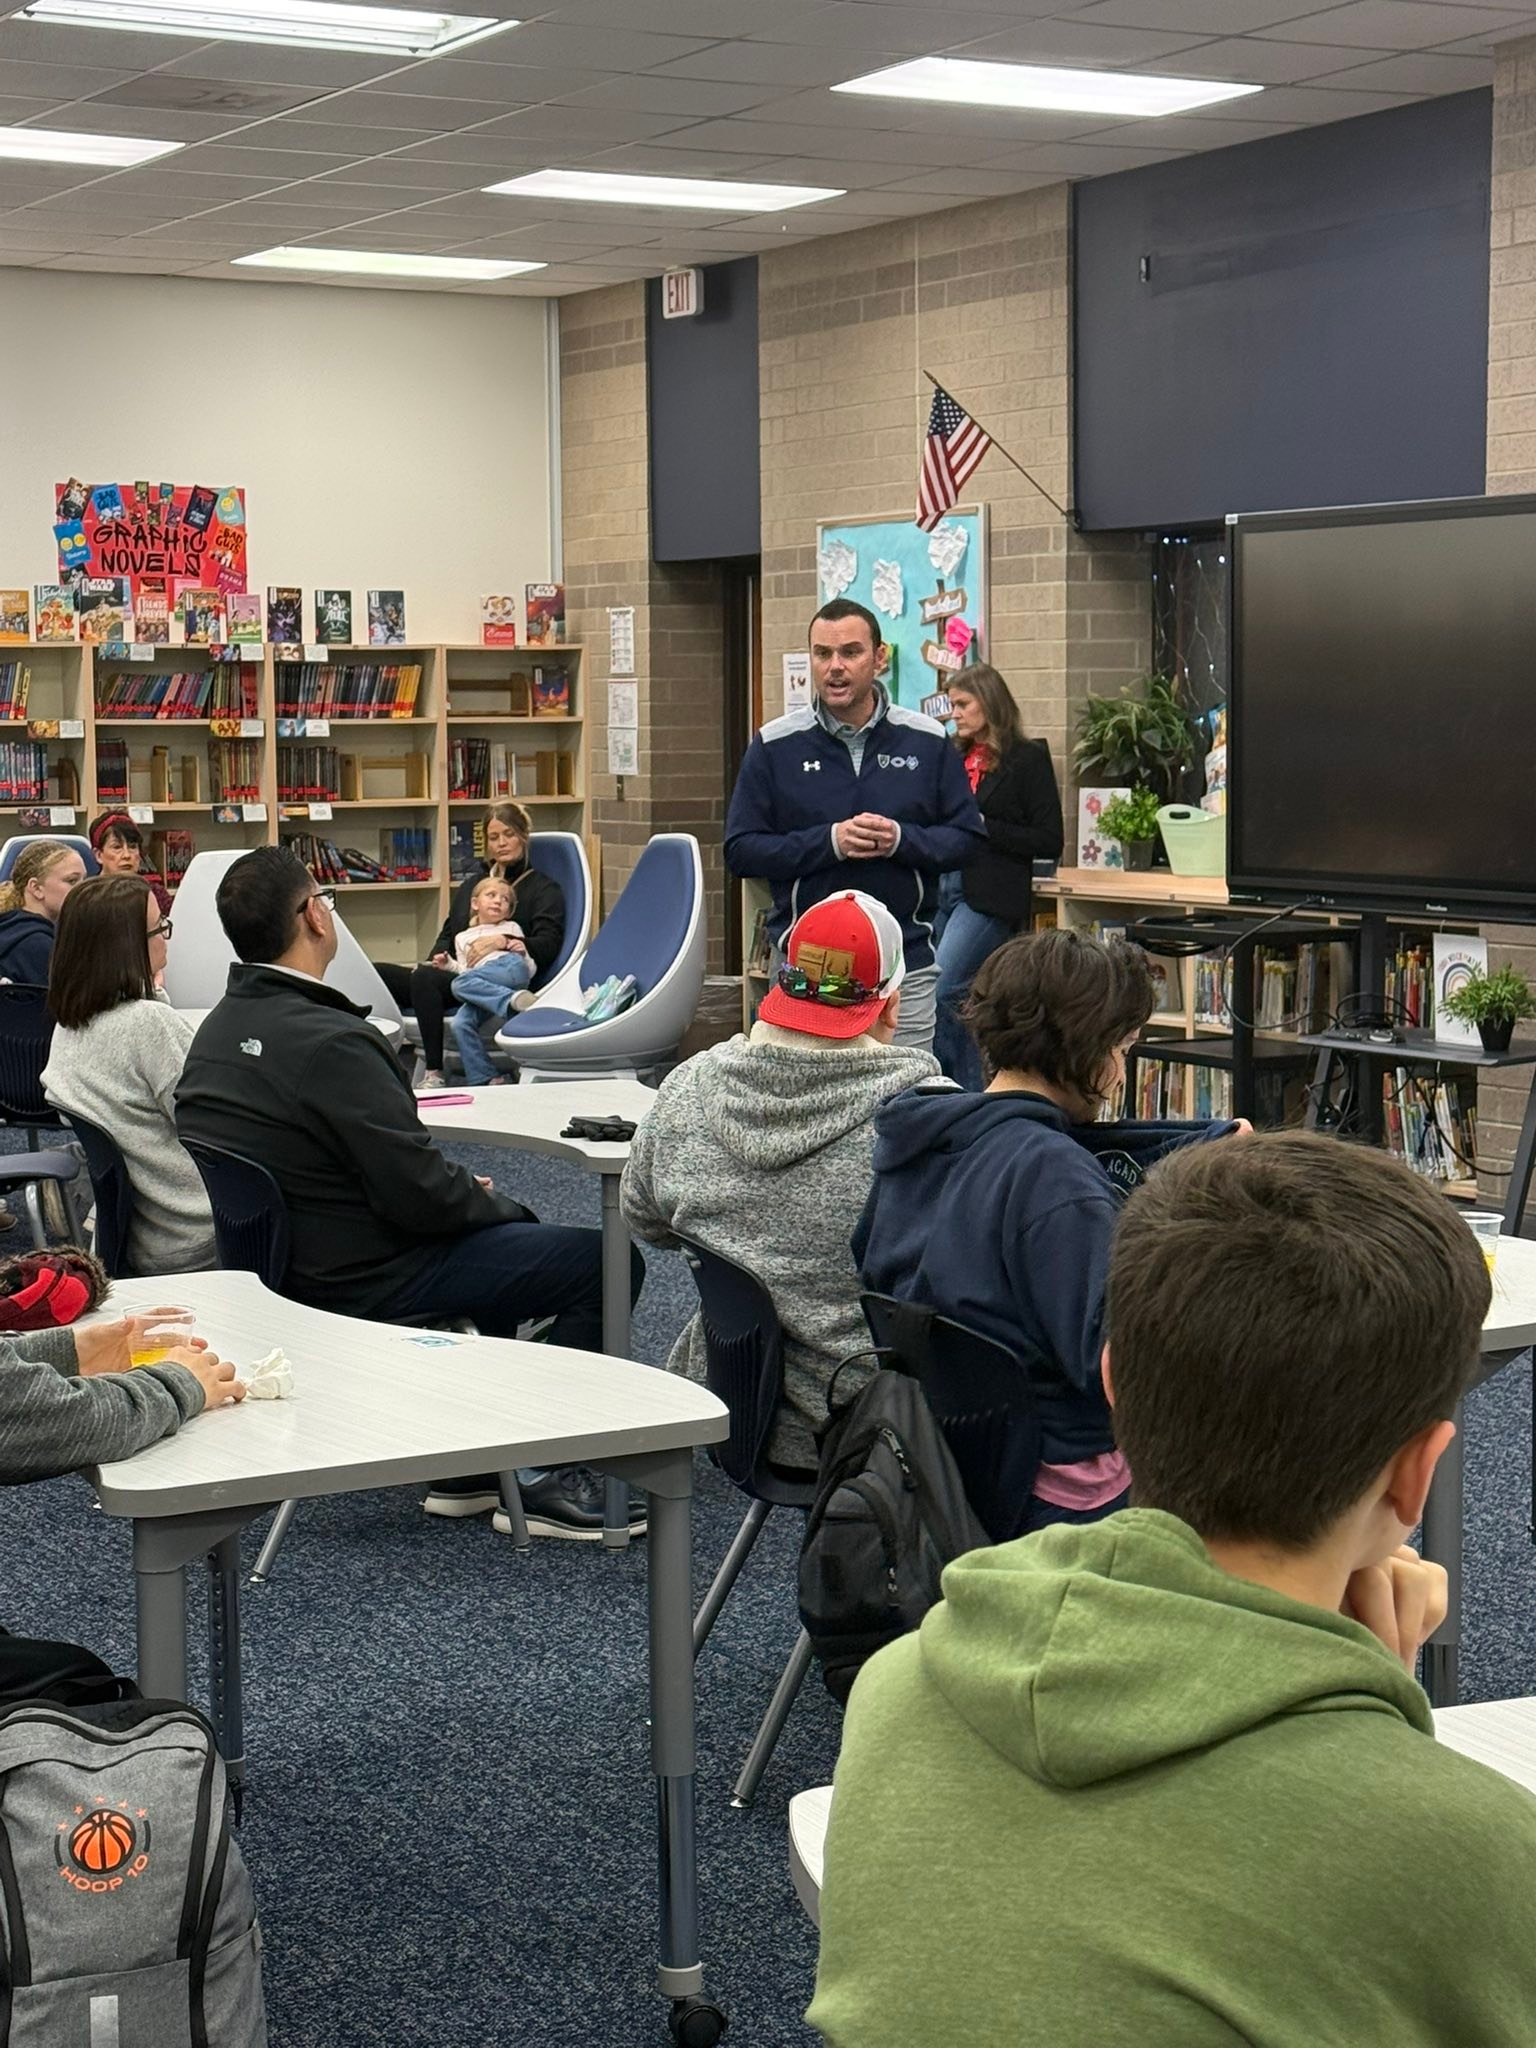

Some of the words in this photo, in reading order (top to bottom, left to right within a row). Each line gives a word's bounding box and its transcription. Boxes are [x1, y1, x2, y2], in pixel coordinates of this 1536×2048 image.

[667, 271, 691, 313] EXIT
[222, 527, 244, 545] BAD
[100, 548, 201, 577] NOVELS
[218, 571, 244, 587] DRAMA
[473, 821, 485, 858] ILLEGAL
[1106, 1159, 1138, 1185] ACAD
[60, 1866, 123, 1893] HOOP
[126, 1854, 149, 1878] 10
